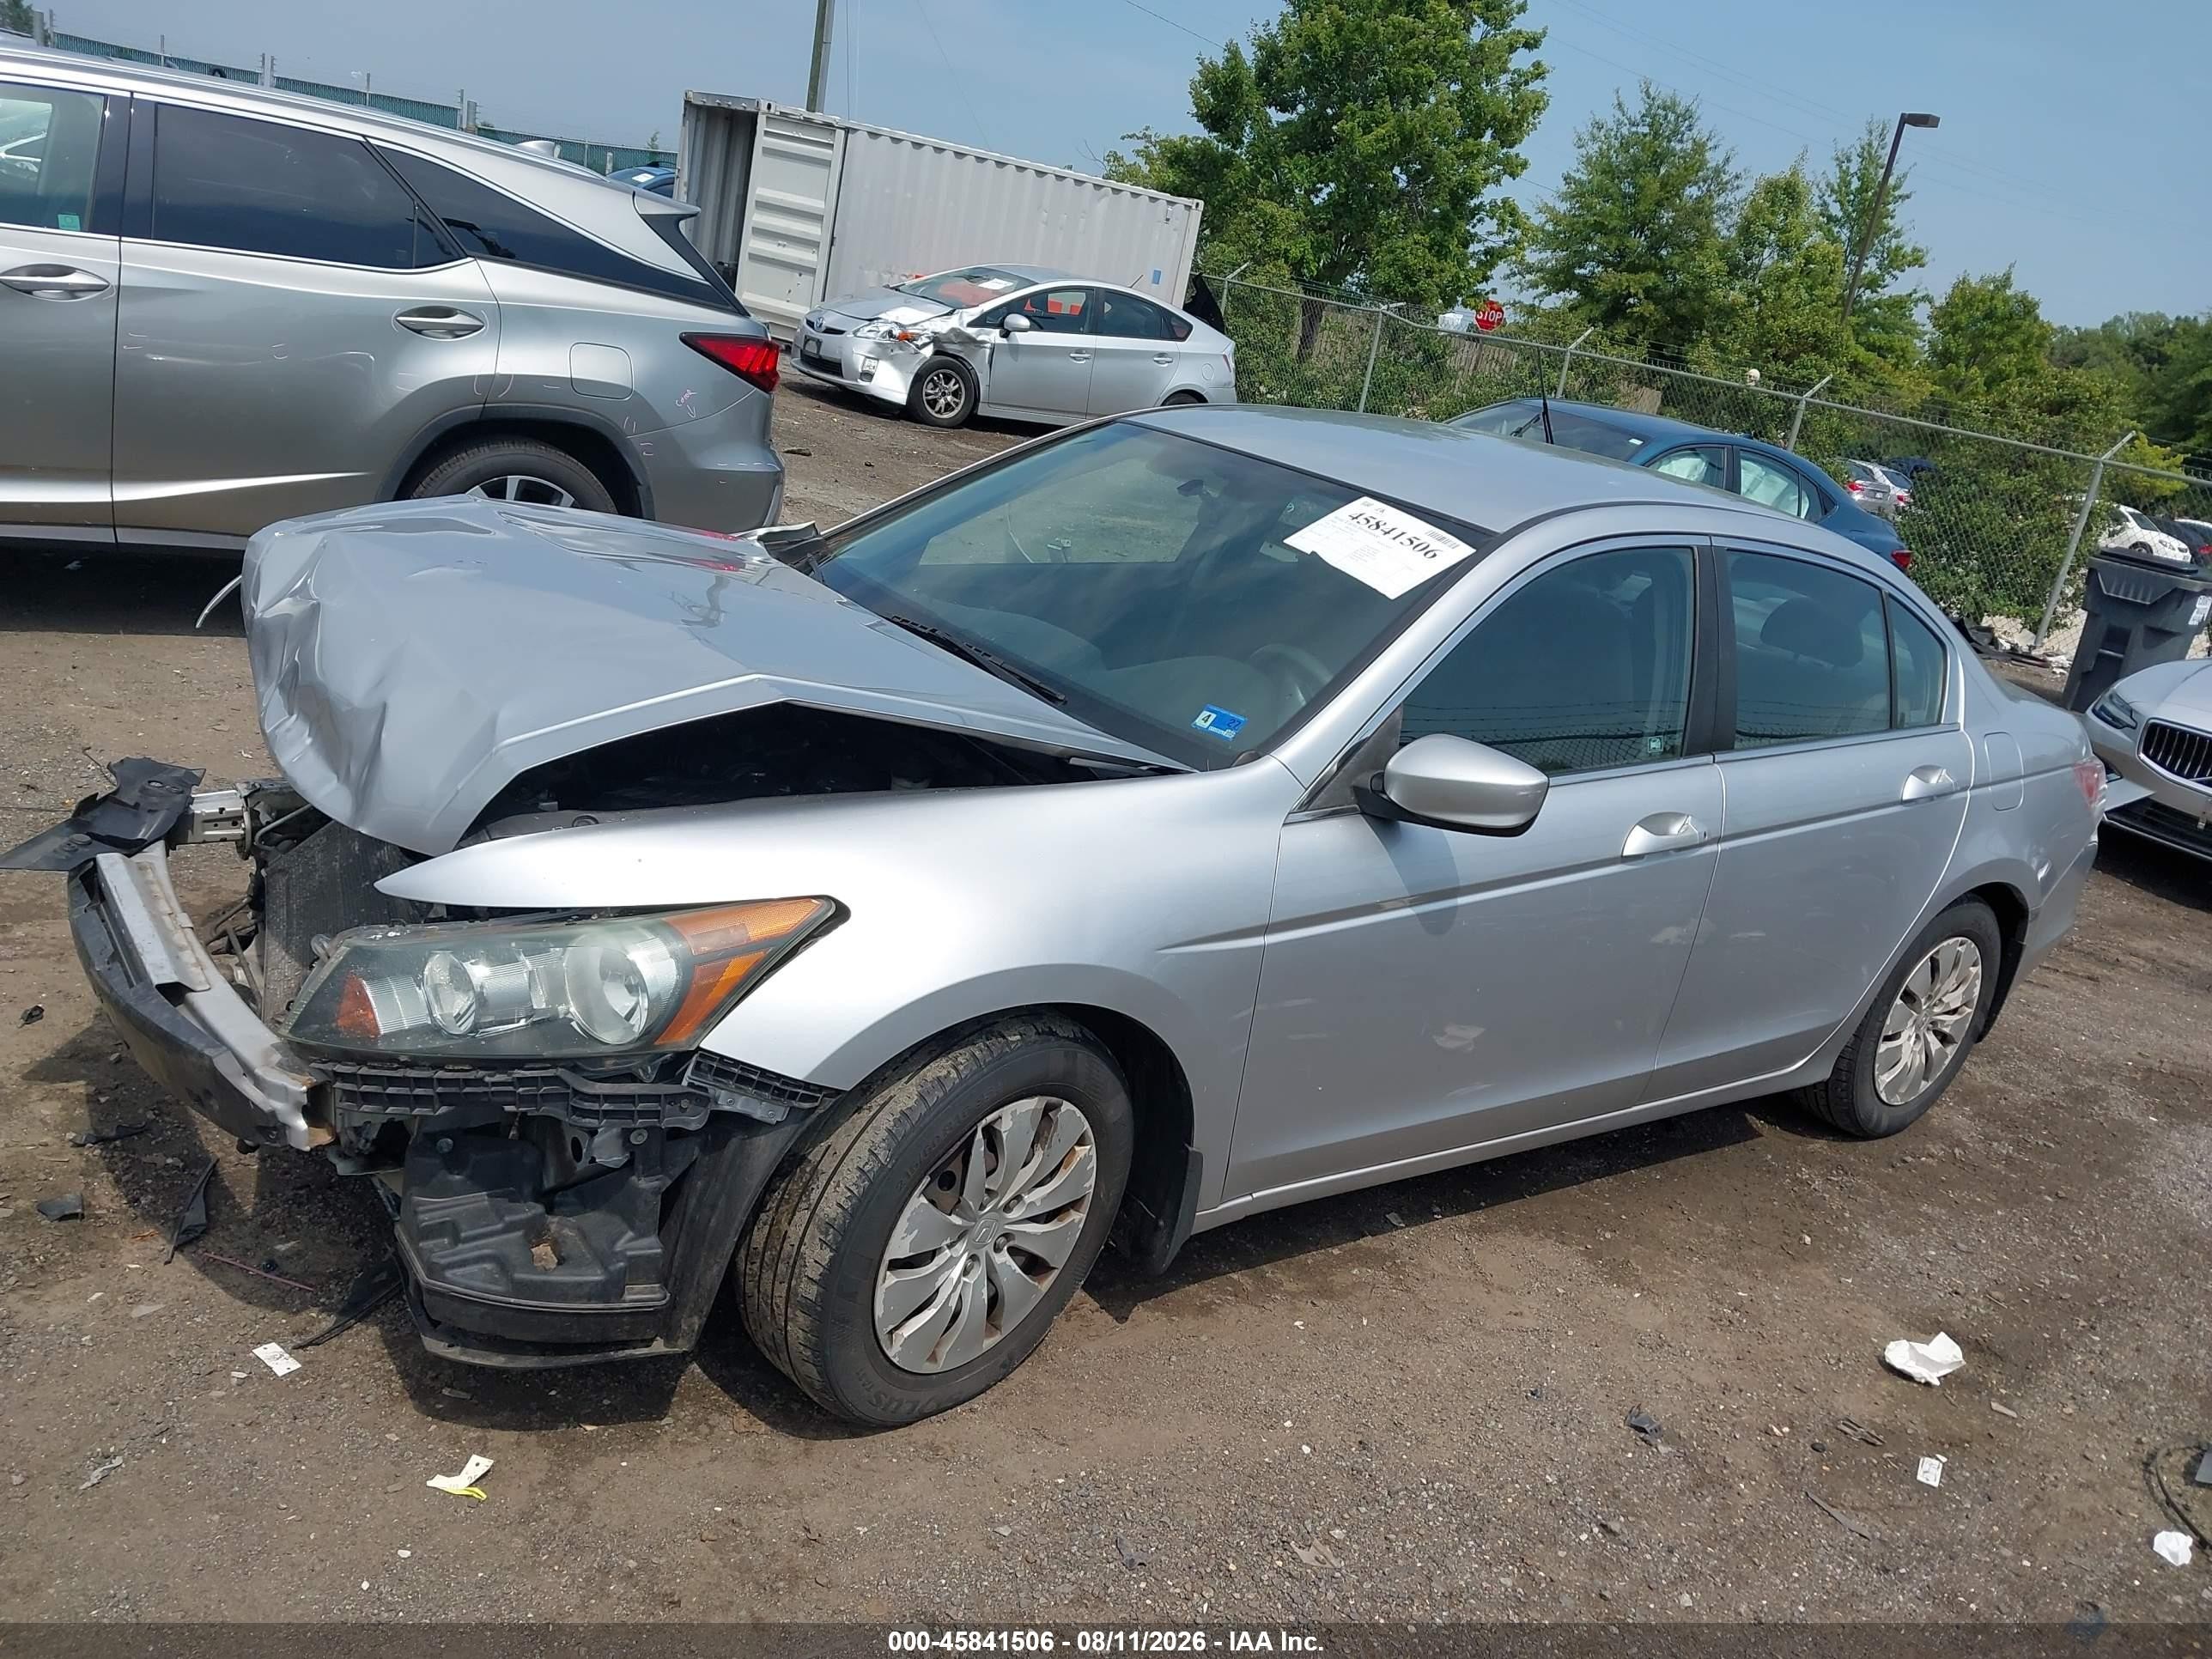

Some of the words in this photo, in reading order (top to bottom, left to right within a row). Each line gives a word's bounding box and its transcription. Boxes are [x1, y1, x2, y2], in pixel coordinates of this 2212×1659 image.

[1477, 310, 1503, 323] STOP
[1348, 513, 1443, 559] 45841506
[1202, 714, 1212, 723] 4
